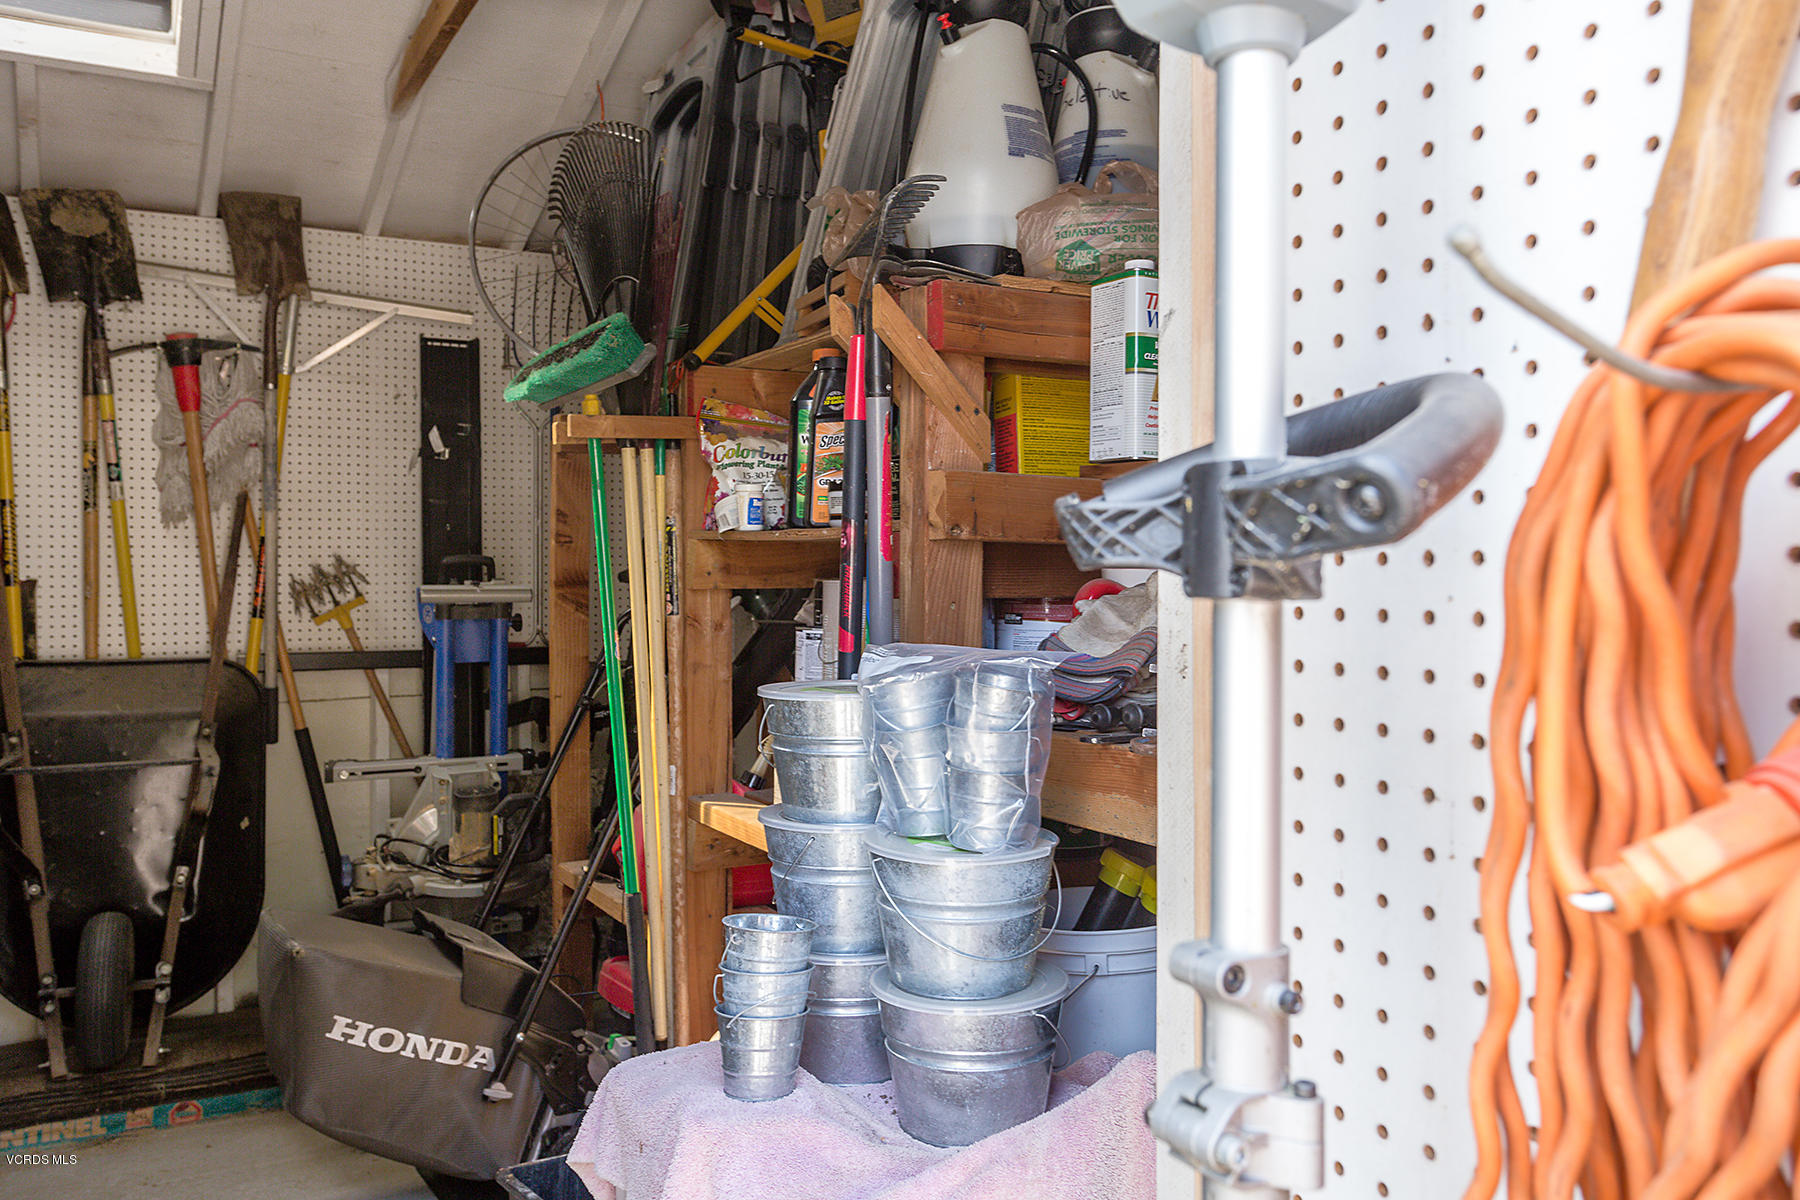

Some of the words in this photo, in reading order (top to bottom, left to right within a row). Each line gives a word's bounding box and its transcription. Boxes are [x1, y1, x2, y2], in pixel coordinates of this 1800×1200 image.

[1055, 225, 1118, 240] STOREWIDE
[1114, 234, 1137, 243] FOR
[1063, 249, 1095, 261] PRICE
[820, 435, 844, 448] Spec
[325, 1014, 496, 1073] HONDA
[0, 1115, 107, 1149] NTINEL
